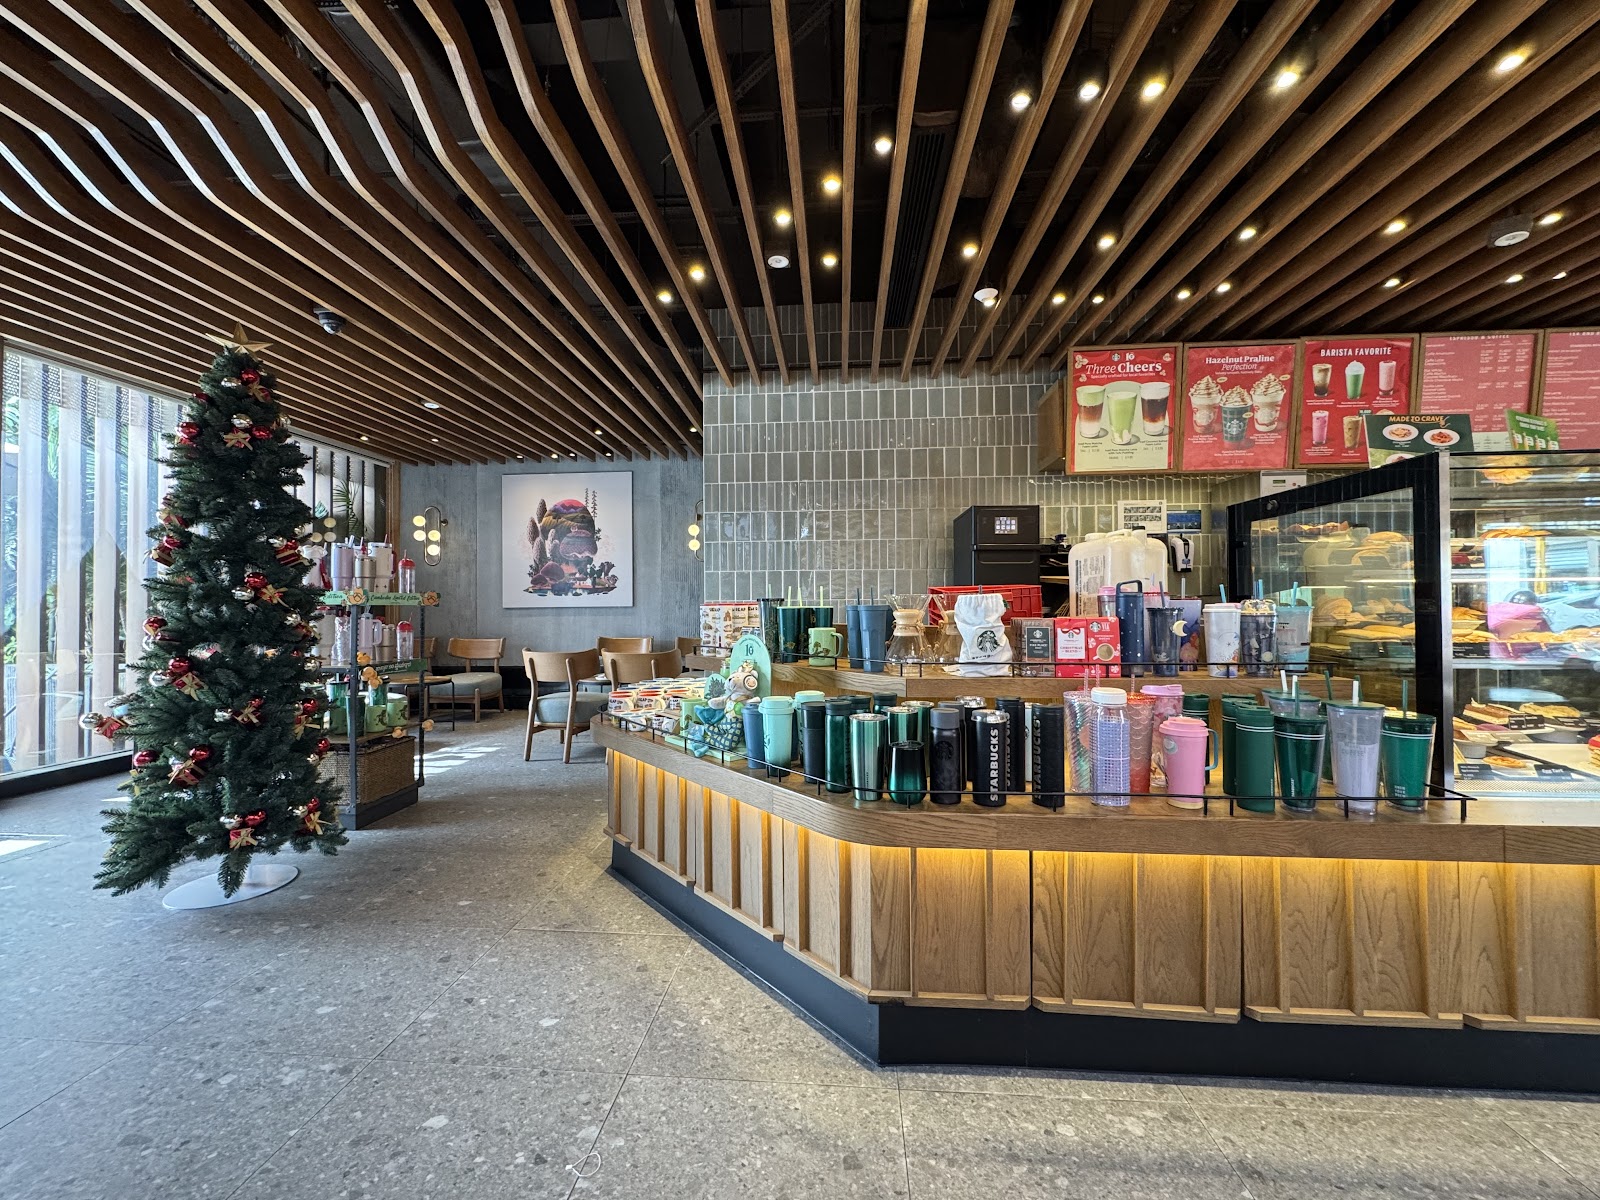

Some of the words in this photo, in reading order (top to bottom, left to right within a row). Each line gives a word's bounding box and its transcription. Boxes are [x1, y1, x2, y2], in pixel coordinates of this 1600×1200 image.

[1320, 349, 1353, 357] BARISTA
[1355, 347, 1392, 356] FAVORITE
[1206, 356, 1243, 364] Hazelnut
[1244, 354, 1275, 363] Praline
[1085, 364, 1116, 375] Three
[1117, 361, 1162, 373] Cheers
[1221, 363, 1258, 371] Perfection
[745, 643, 754, 656] 10
[990, 728, 999, 802] STARBUCKS
